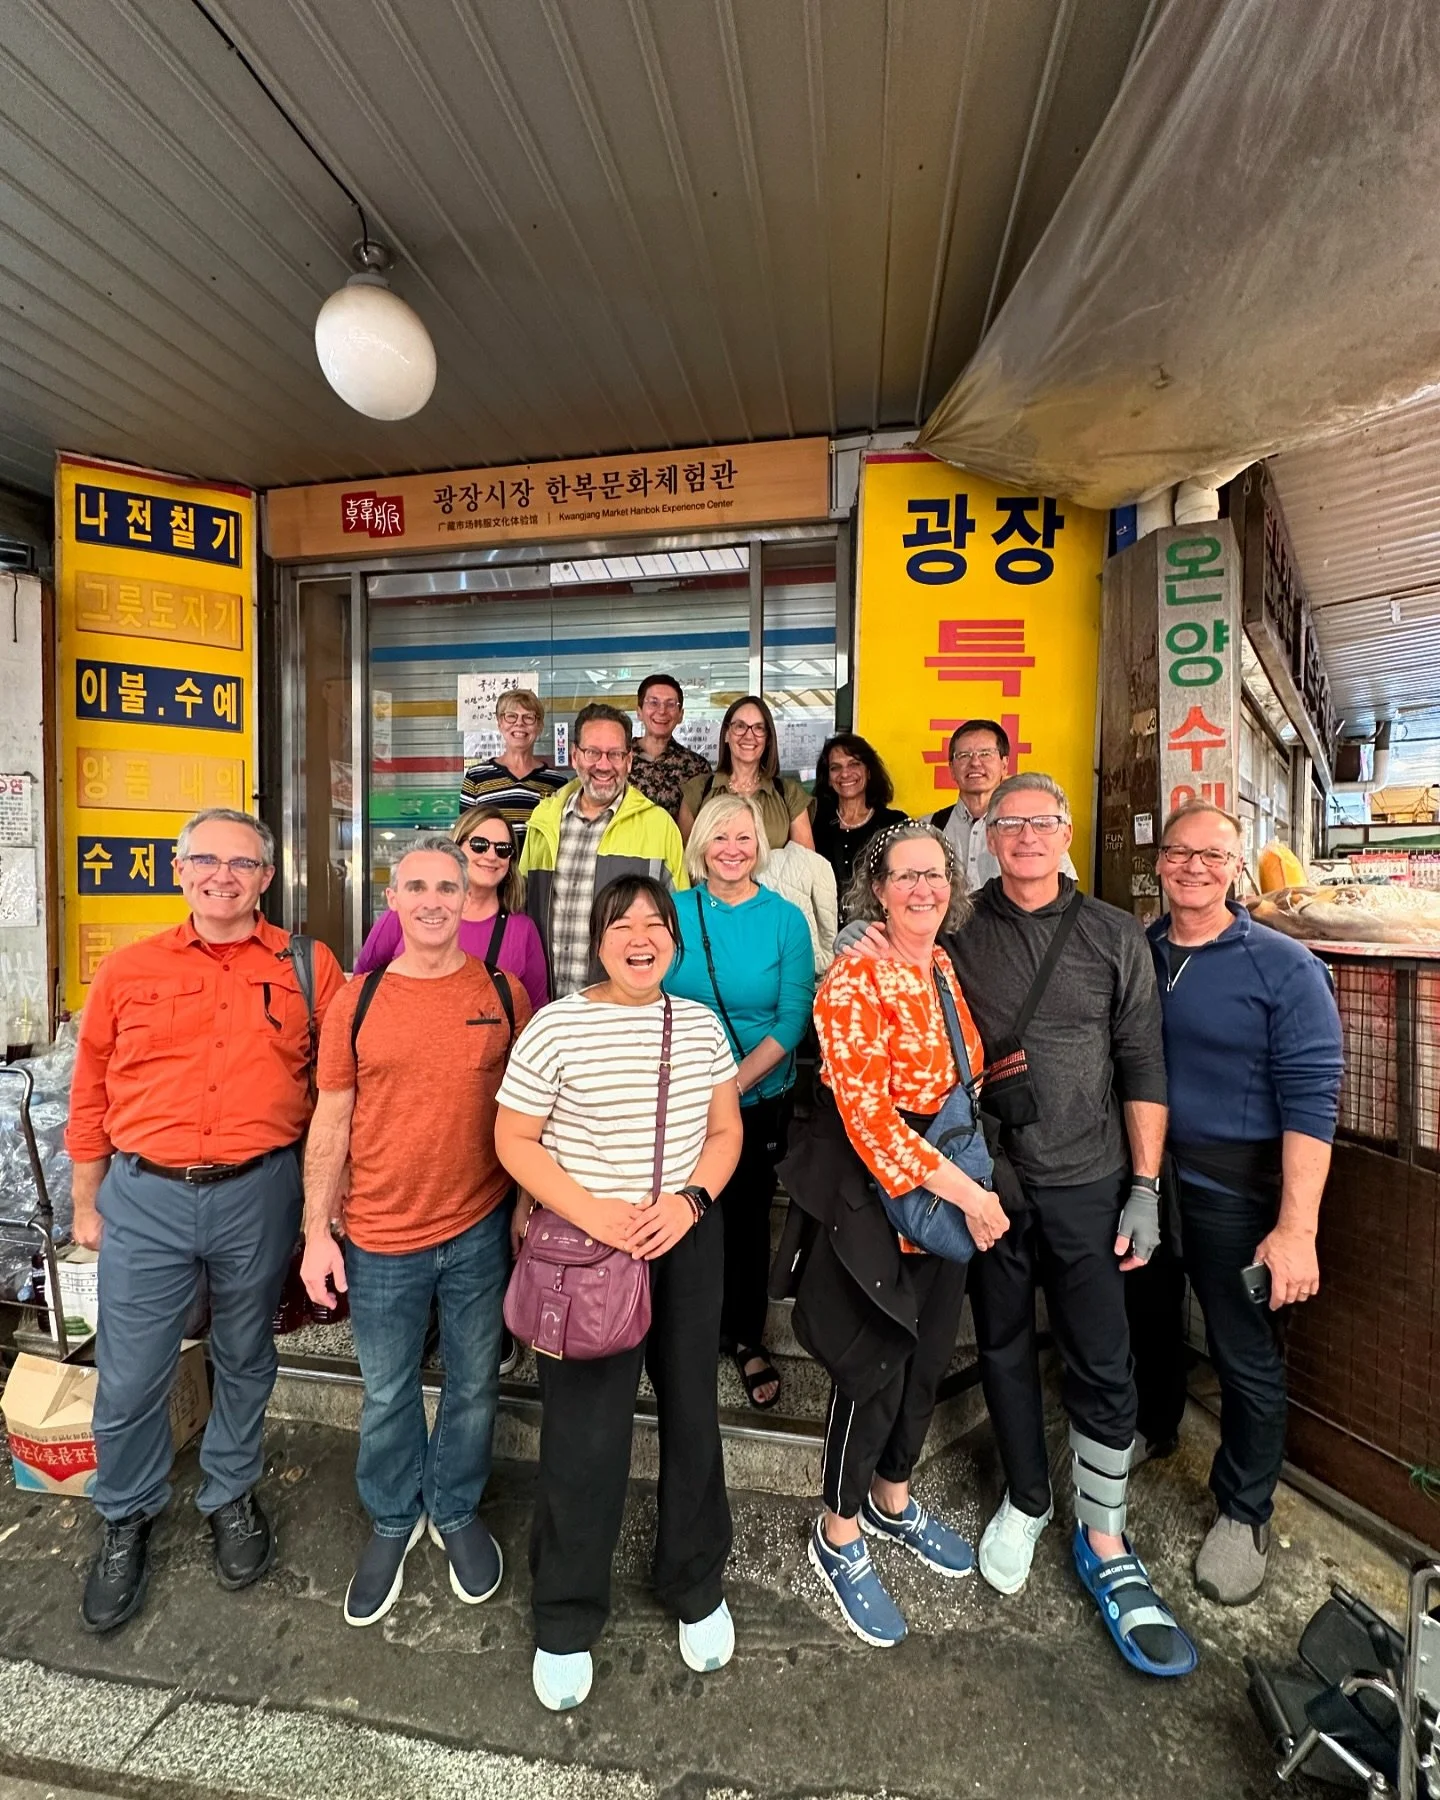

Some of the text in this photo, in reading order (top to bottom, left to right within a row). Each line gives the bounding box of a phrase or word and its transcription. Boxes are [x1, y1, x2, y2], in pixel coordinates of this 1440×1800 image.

[433, 459, 739, 515] 광장시장 한복문화체험관
[559, 499, 734, 522] Kwangjang Market Hanbok Experience Center
[902, 493, 1065, 586] 광장
[82, 581, 237, 642] 그릇도자기
[1105, 833, 1124, 843] FUN
[1105, 842, 1123, 851] STUFF
[83, 843, 181, 888] 수저
